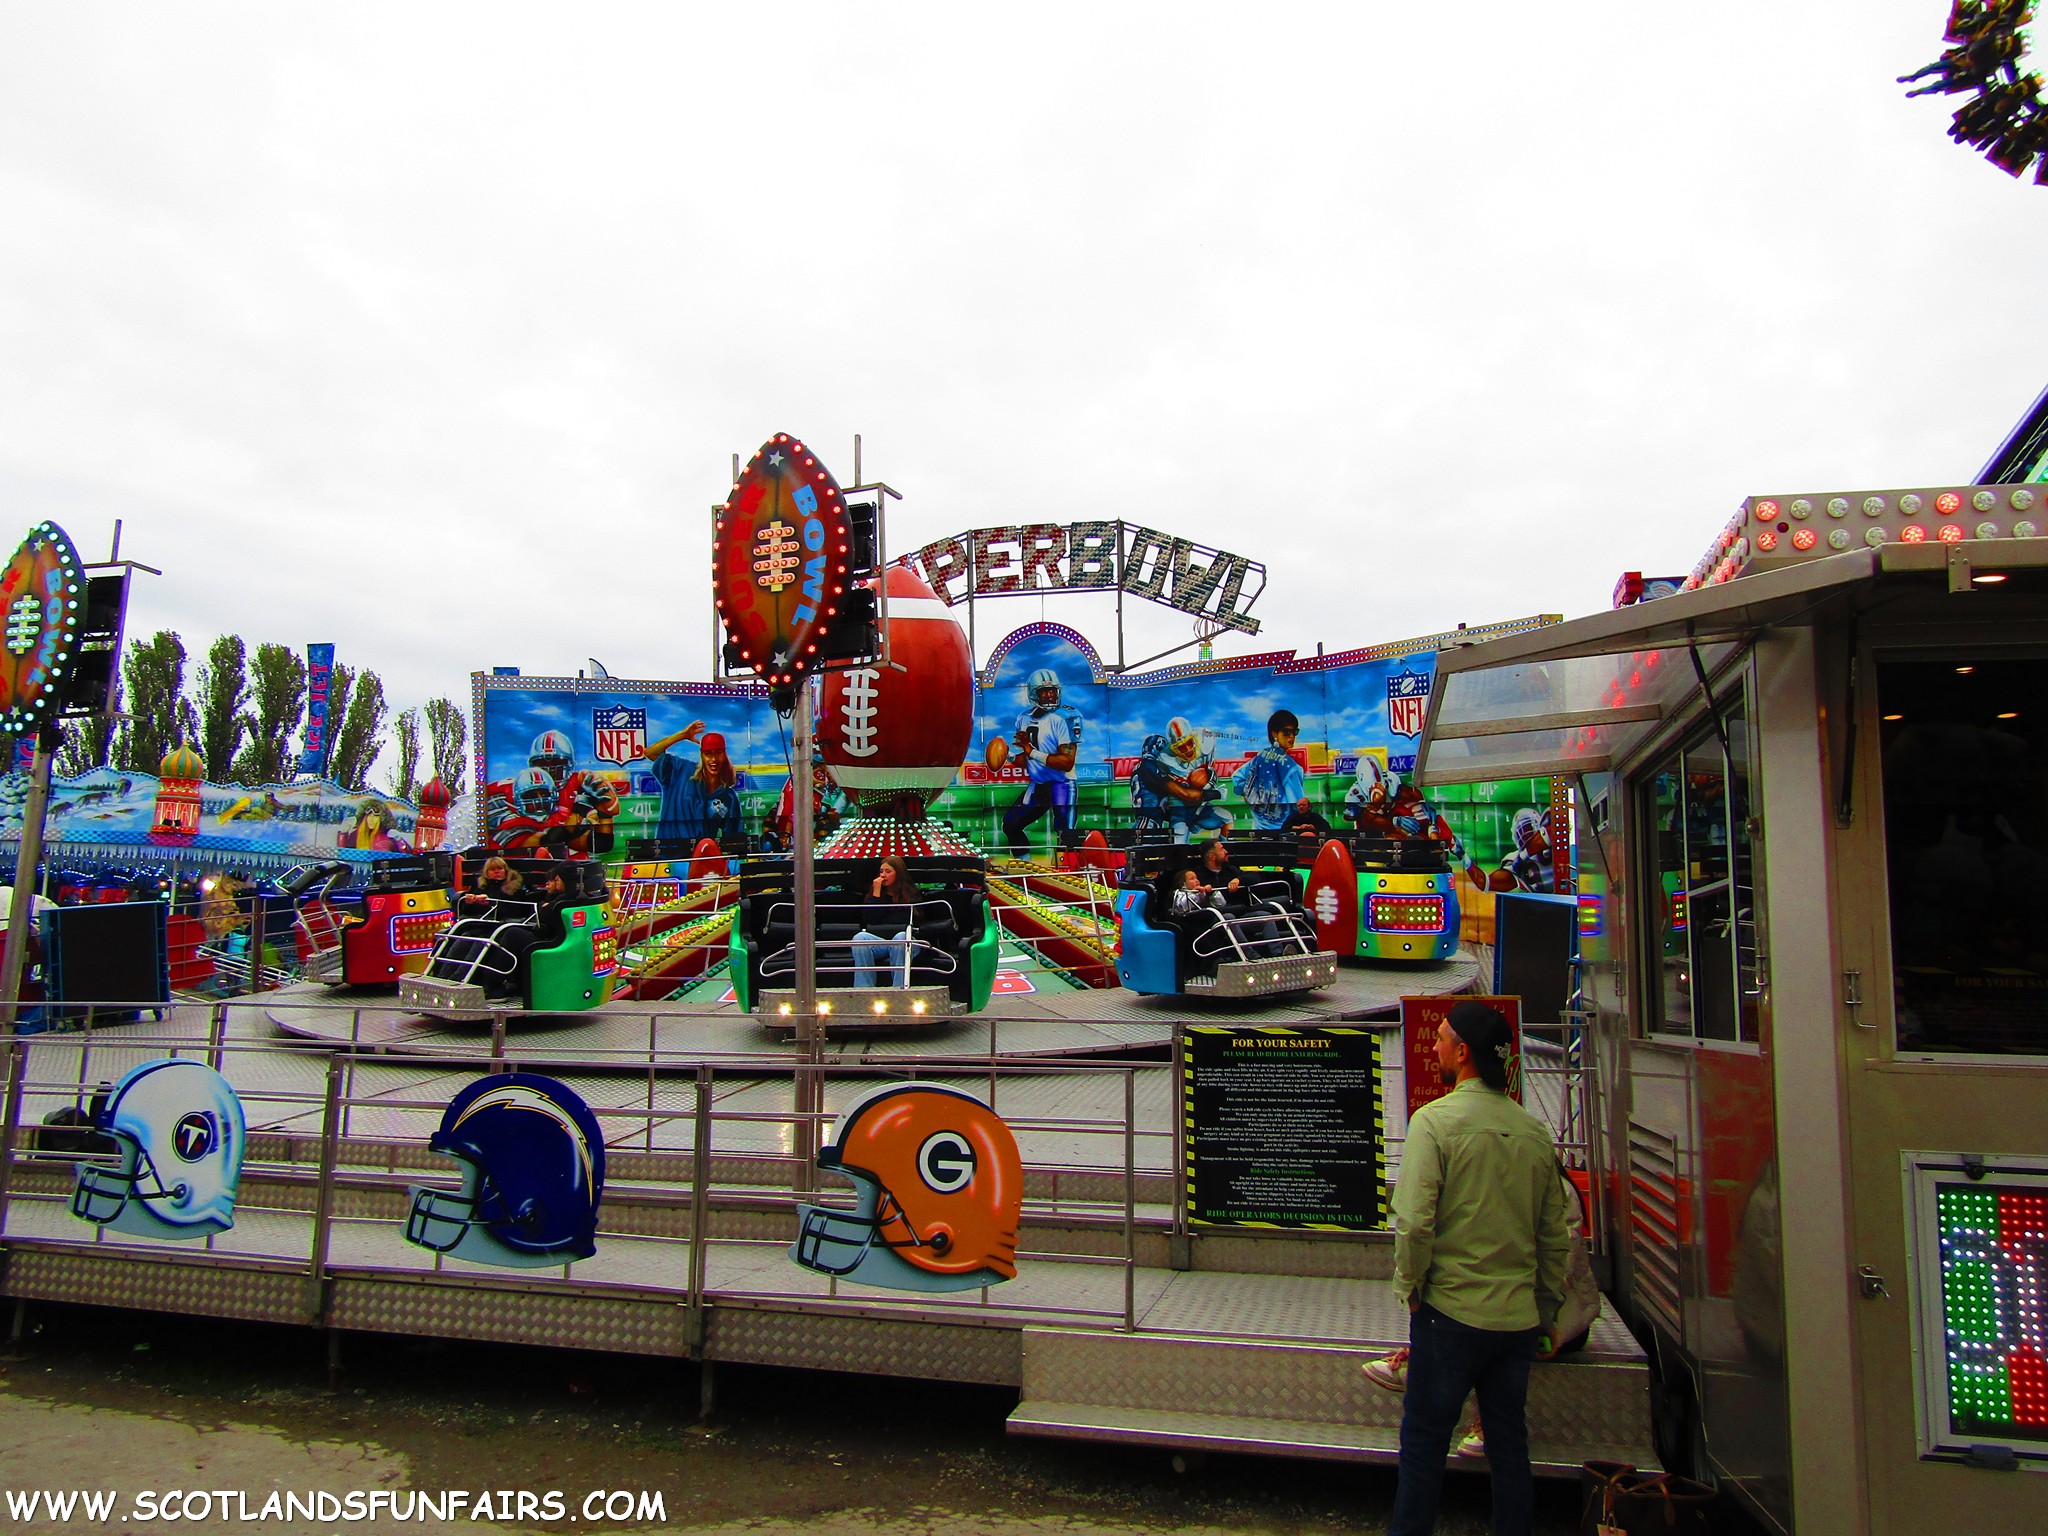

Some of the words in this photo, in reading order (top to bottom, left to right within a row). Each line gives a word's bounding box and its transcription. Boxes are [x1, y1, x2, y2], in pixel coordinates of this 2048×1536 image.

[730, 482, 768, 637] SUPER
[791, 483, 828, 626] BOWL
[899, 521, 1262, 636] PERBOWL
[26, 567, 63, 686] BOWL
[597, 729, 645, 761] NFL
[1124, 894, 1136, 911] 1
[1232, 1038, 1254, 1048] FOR
[1256, 1038, 1287, 1048] YOUR
[1289, 1038, 1332, 1048] SAFETY
[1414, 1086, 1439, 1095] Ride
[919, 1132, 973, 1192] G
